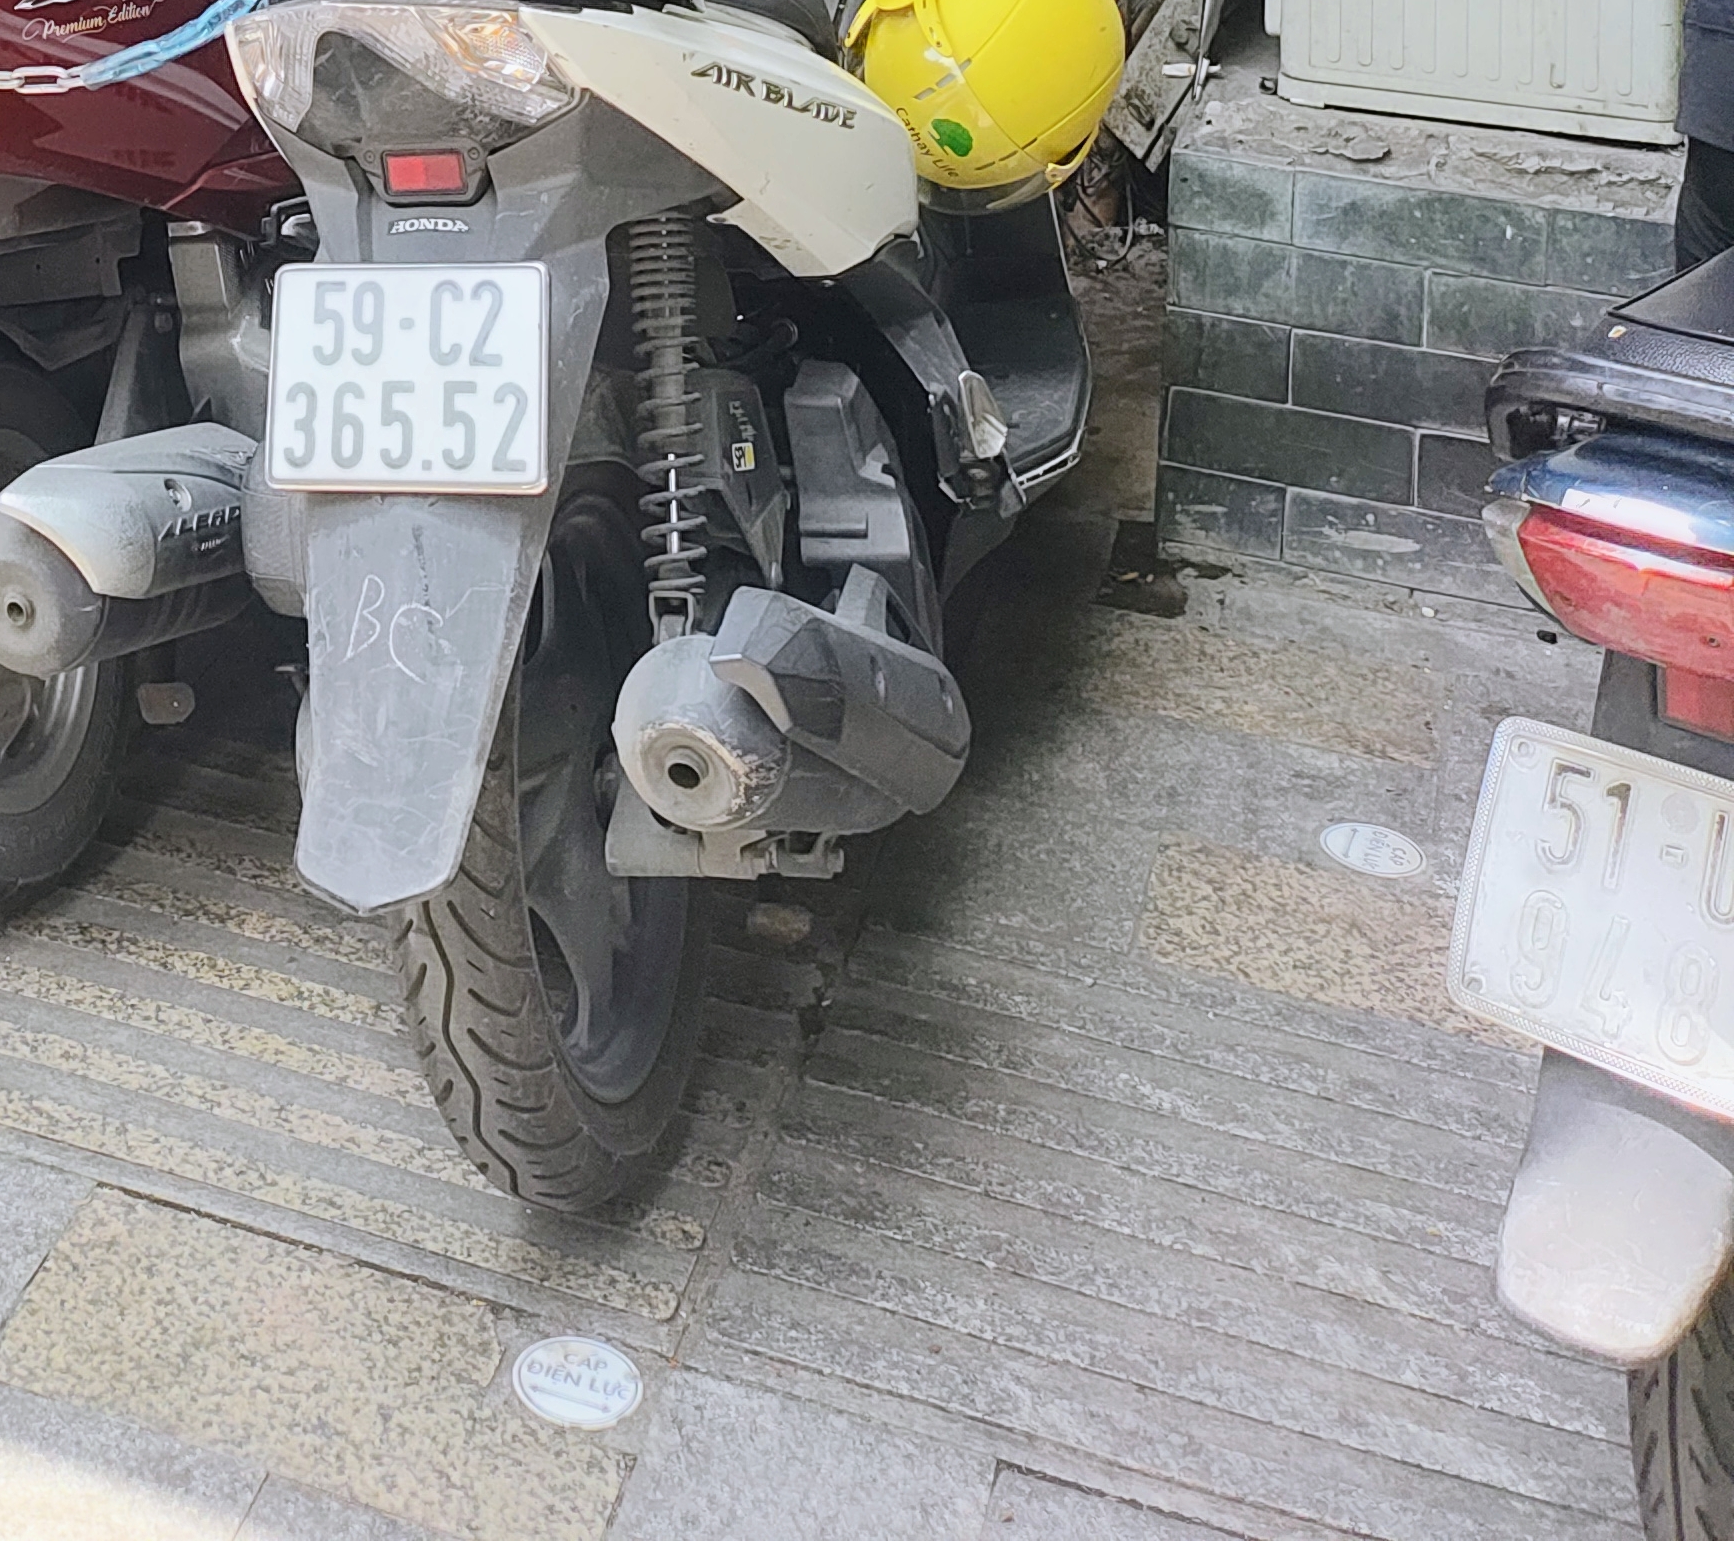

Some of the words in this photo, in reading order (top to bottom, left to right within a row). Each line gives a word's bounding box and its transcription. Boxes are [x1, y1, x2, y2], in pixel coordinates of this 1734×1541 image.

[22, 16, 107, 44] Premium
[690, 60, 756, 98] AIR
[761, 78, 858, 130] BLADE
[894, 106, 935, 158] Cathay
[930, 157, 960, 179] Life
[388, 217, 469, 235] HONDA
[311, 278, 505, 368] 59-C2
[282, 378, 530, 476] 365.52
[526, 1359, 583, 1388] ĐIỆN
[587, 1375, 631, 1401] LỰC
[563, 1352, 609, 1373] CÁP
